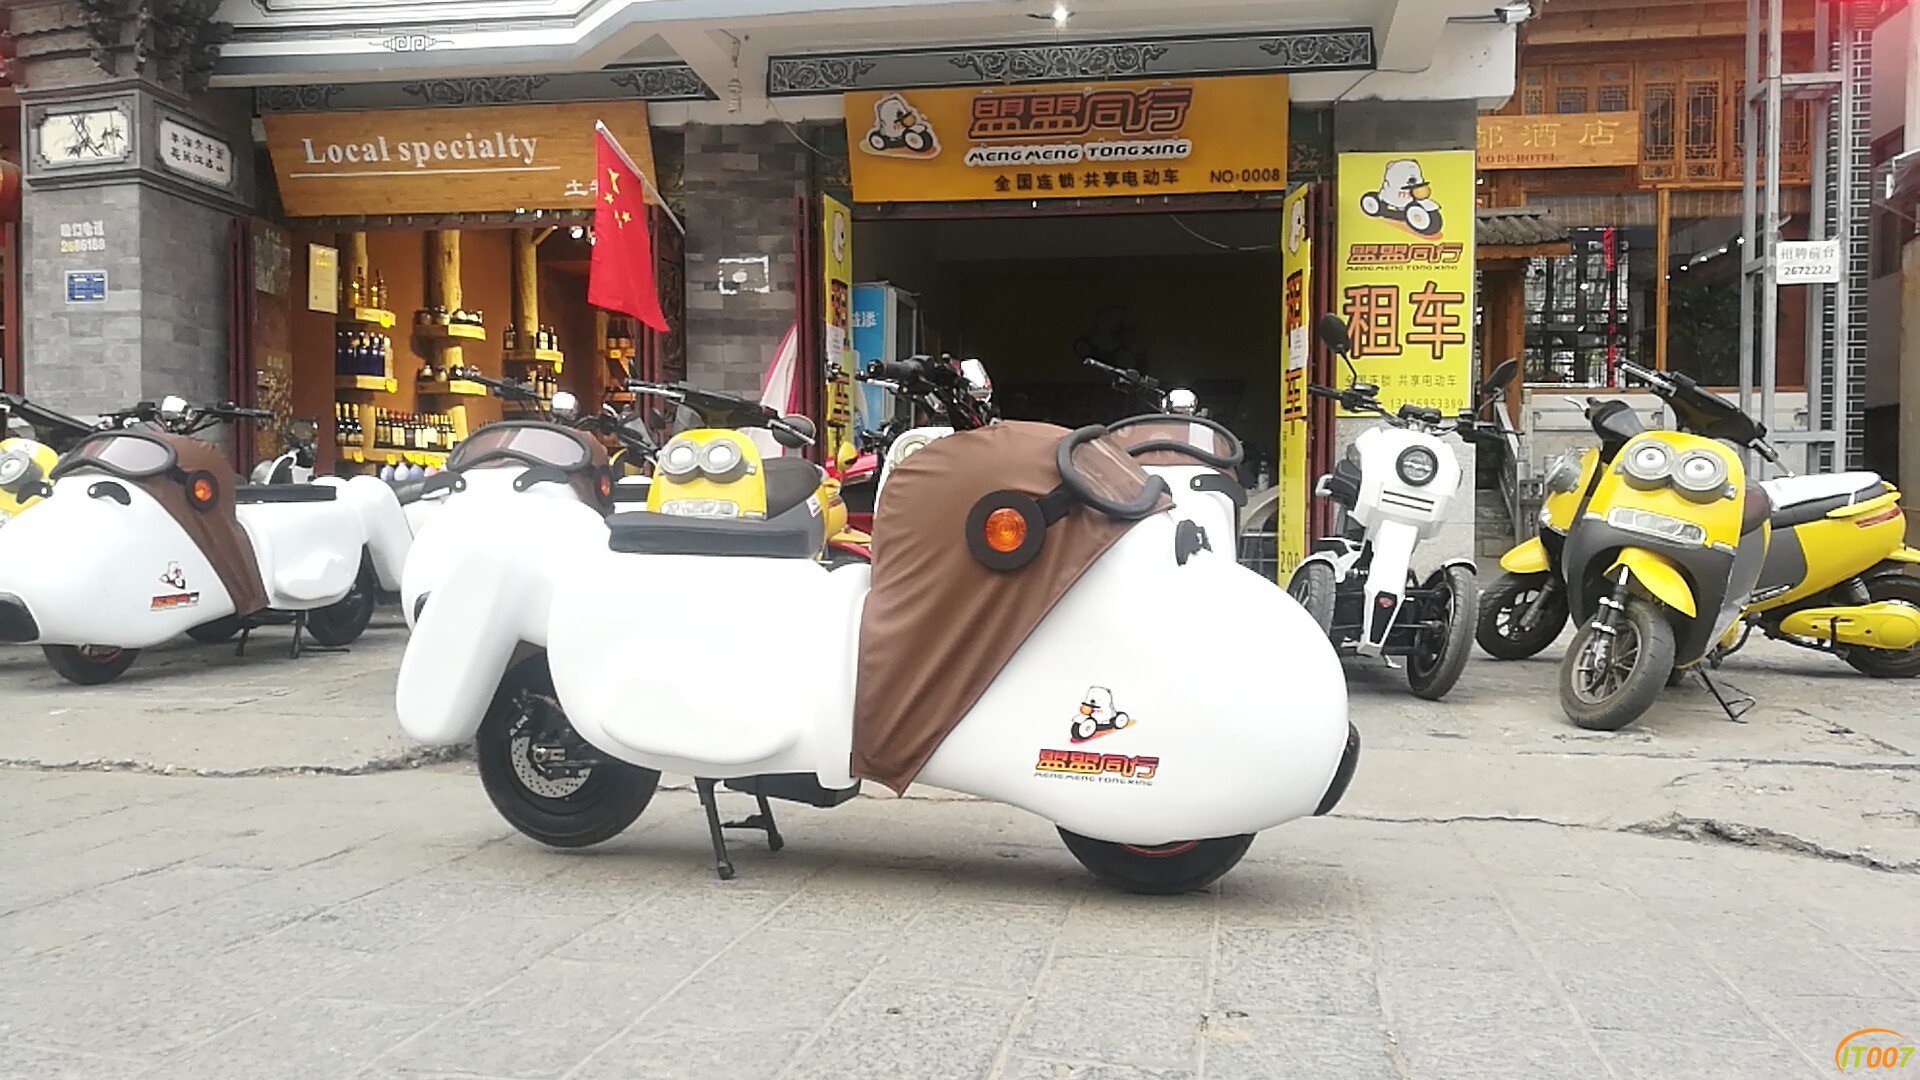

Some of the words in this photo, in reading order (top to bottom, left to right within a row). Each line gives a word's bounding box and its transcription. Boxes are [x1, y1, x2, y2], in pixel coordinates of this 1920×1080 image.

[967, 87, 1193, 139] 盟盟同行
[301, 136, 391, 164] Local
[398, 132, 538, 168] specialty
[1347, 242, 1463, 264] 盟盟同行
[1784, 265, 1832, 275] 2672222
[1343, 280, 1465, 359] 租车
[1036, 749, 1159, 778] 盟盟同行
